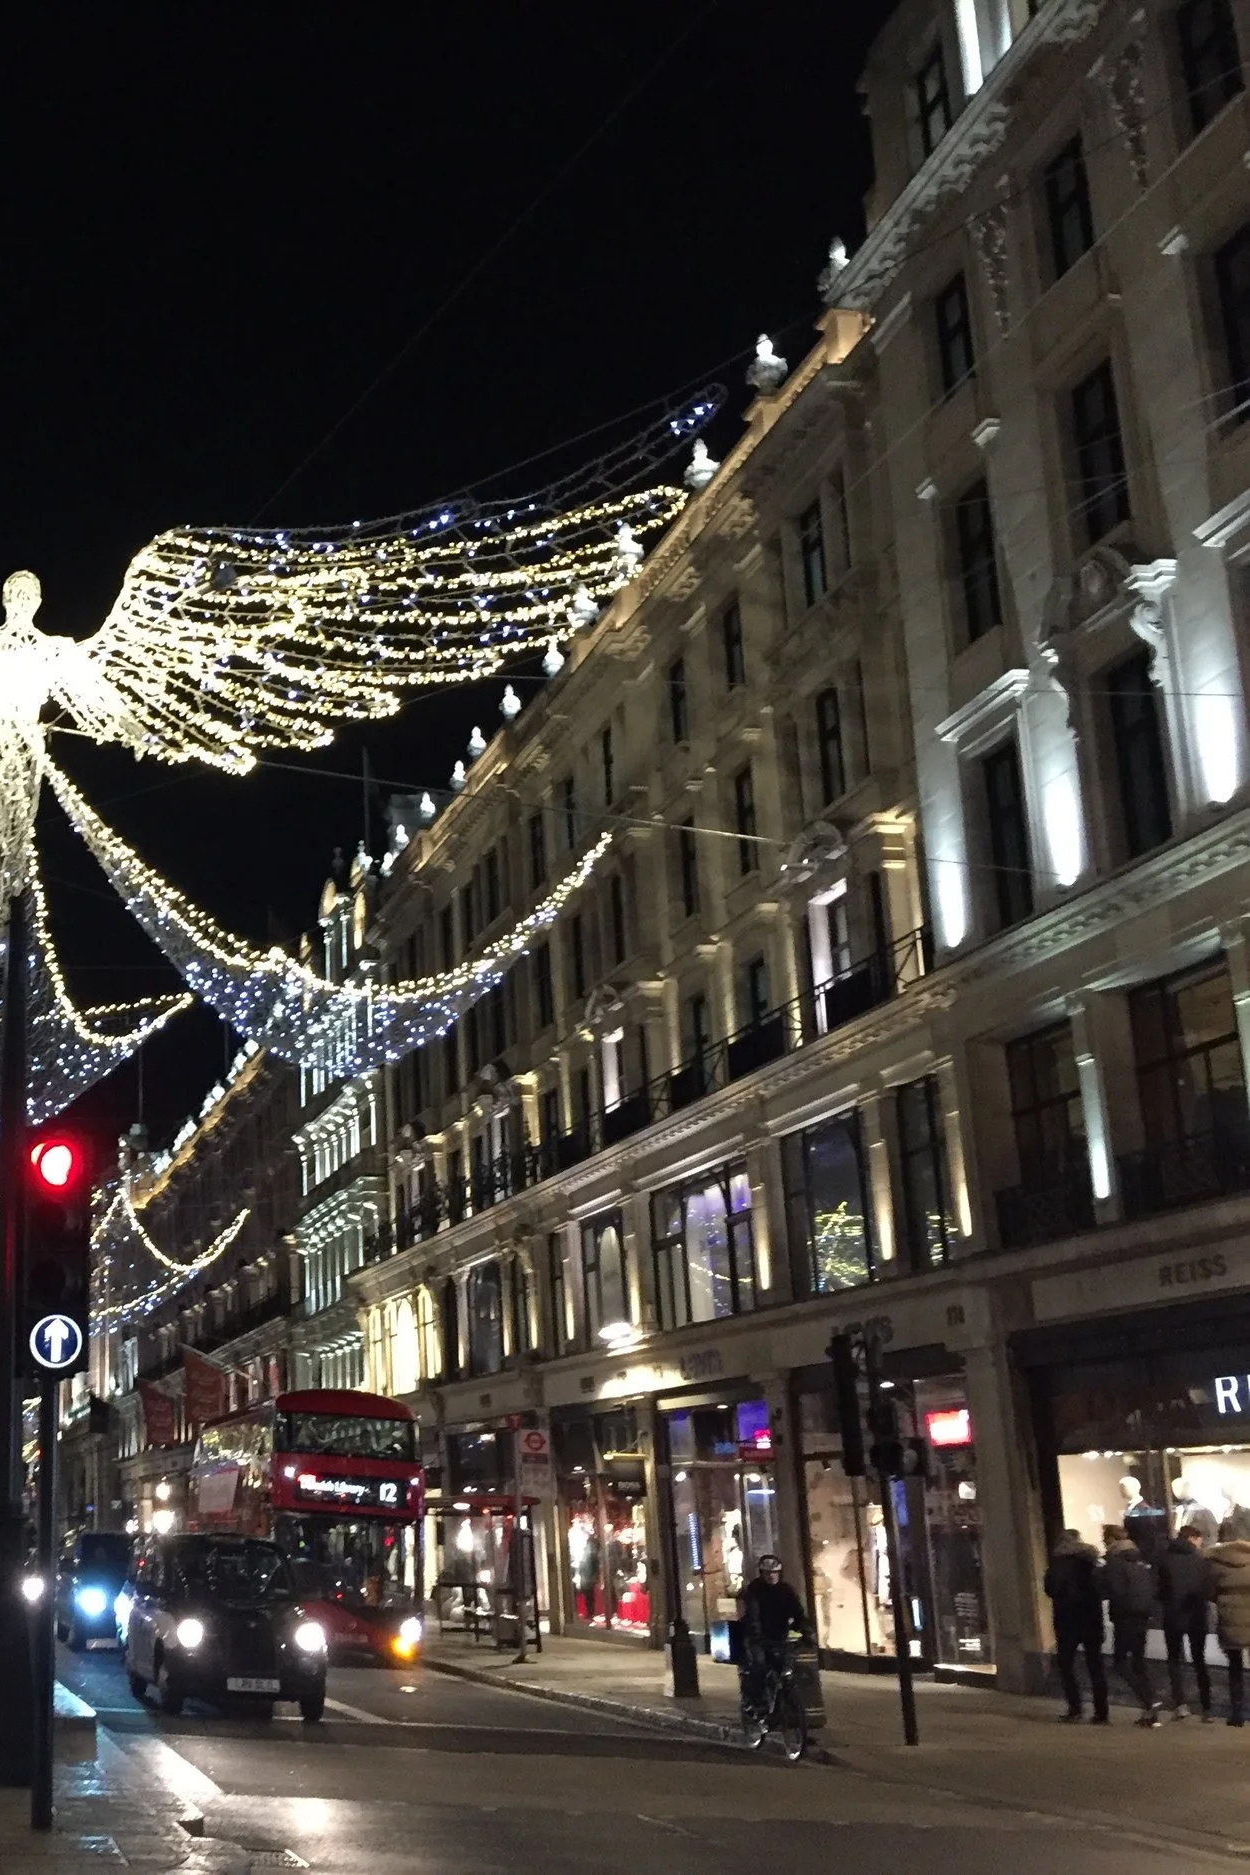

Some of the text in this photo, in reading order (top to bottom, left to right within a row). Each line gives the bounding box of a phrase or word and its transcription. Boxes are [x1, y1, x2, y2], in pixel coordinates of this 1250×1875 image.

[1159, 1253, 1227, 1287] REISS
[1214, 1374, 1250, 1413] R
[379, 1482, 398, 1503] 12
